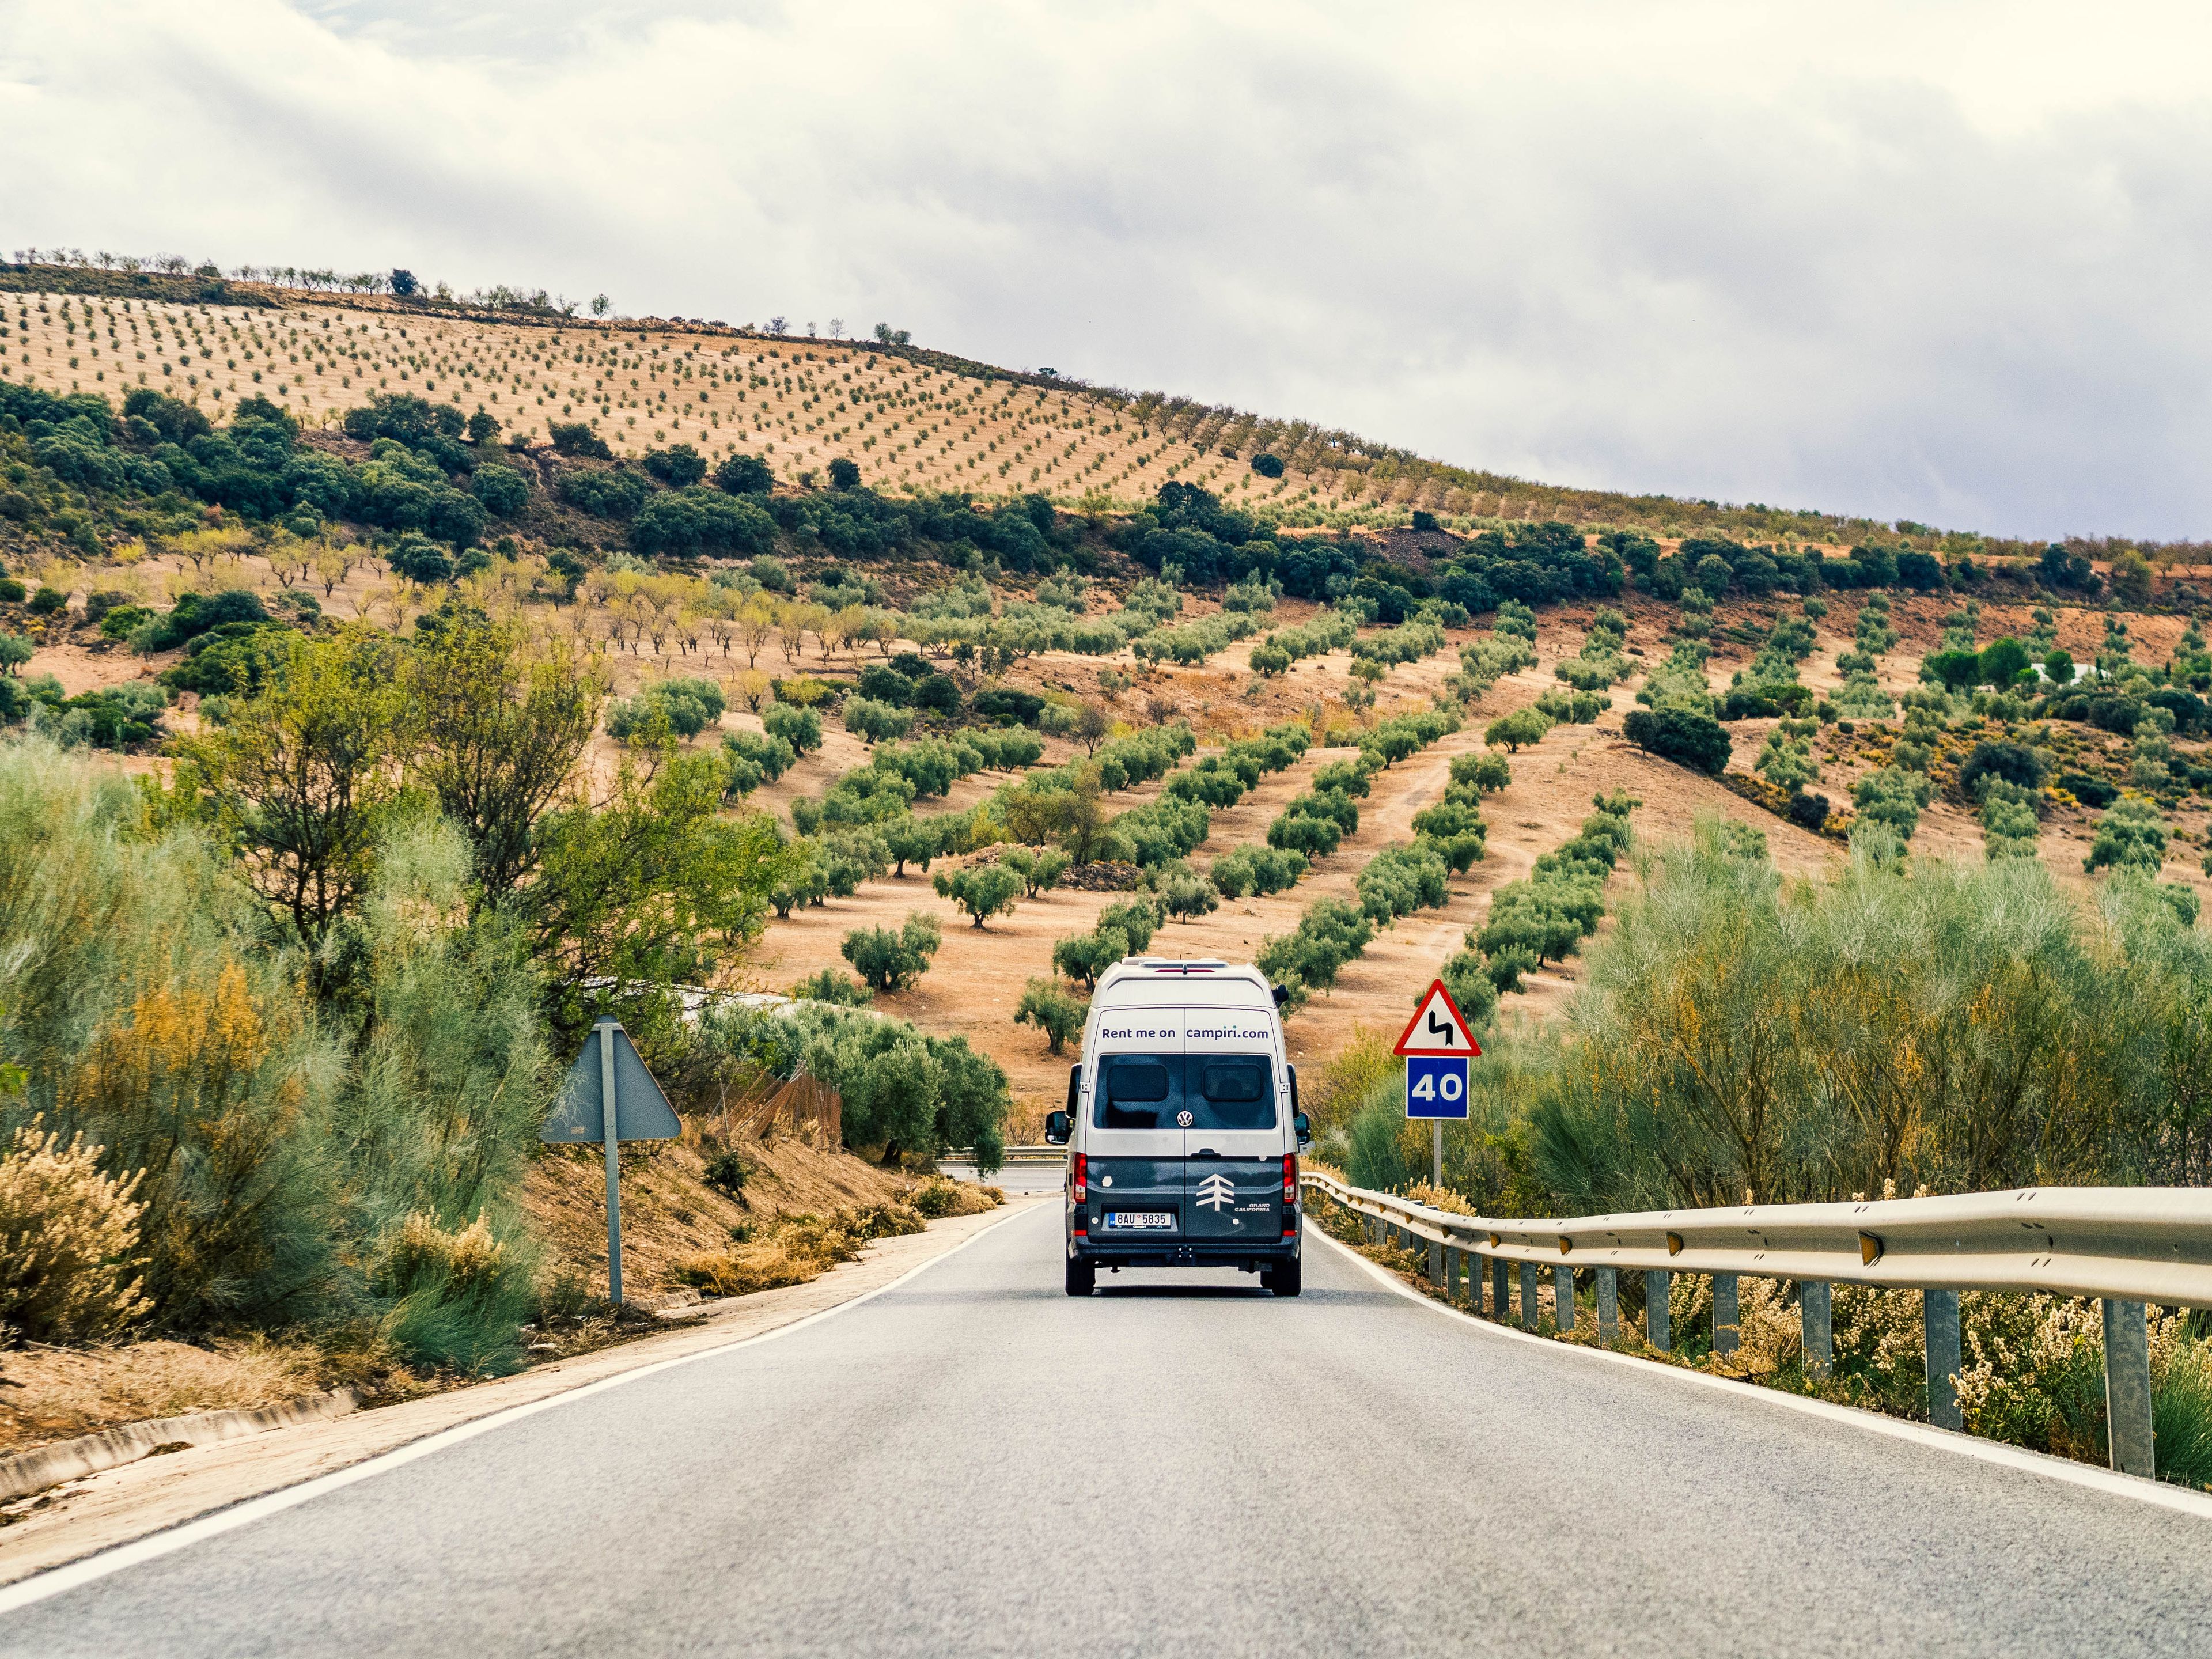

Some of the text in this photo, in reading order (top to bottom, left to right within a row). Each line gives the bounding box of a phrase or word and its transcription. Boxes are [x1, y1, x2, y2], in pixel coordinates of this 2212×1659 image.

[1102, 1025, 1268, 1040] Rent me on campiri.com
[1411, 1073, 1463, 1101] 40
[1118, 1214, 1166, 1224] 8AU 5835
